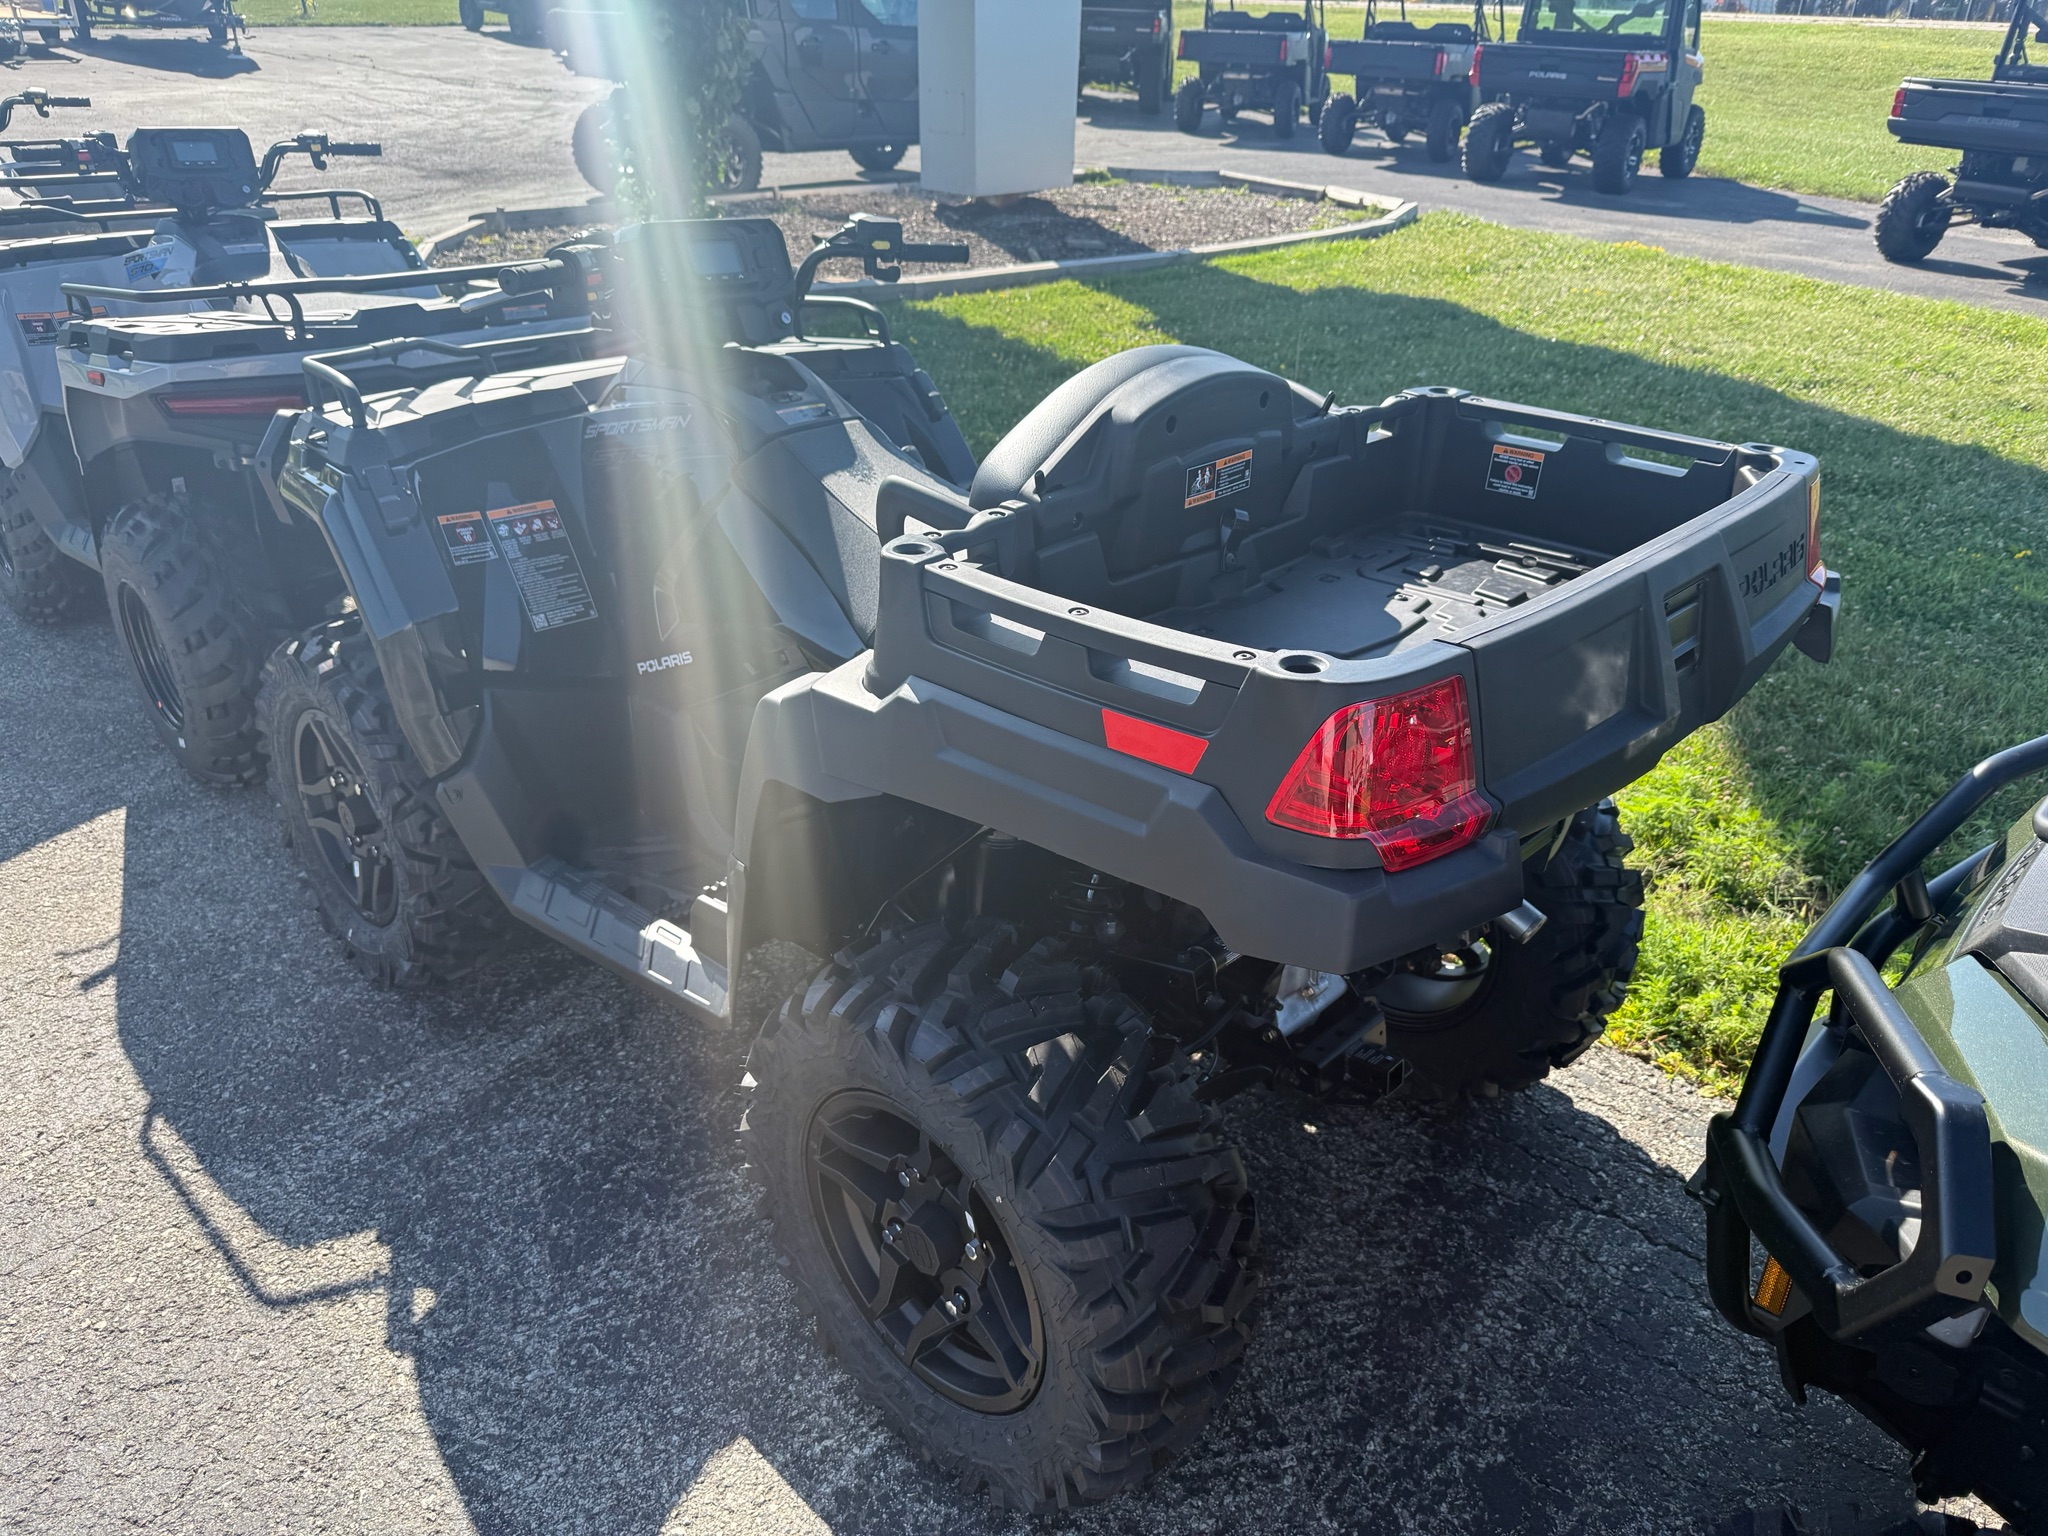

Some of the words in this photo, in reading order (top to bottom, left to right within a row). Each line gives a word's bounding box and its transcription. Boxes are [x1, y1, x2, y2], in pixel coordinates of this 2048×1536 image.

[1528, 70, 1567, 80] POLARIS
[1967, 116, 2021, 128] POLARIS
[124, 246, 174, 266] SPORTSMAN
[584, 414, 692, 439] SPORTSMAN
[1509, 448, 1534, 459] WARNING
[1739, 533, 1804, 599] POLARIS
[637, 651, 693, 675] POLARIS
